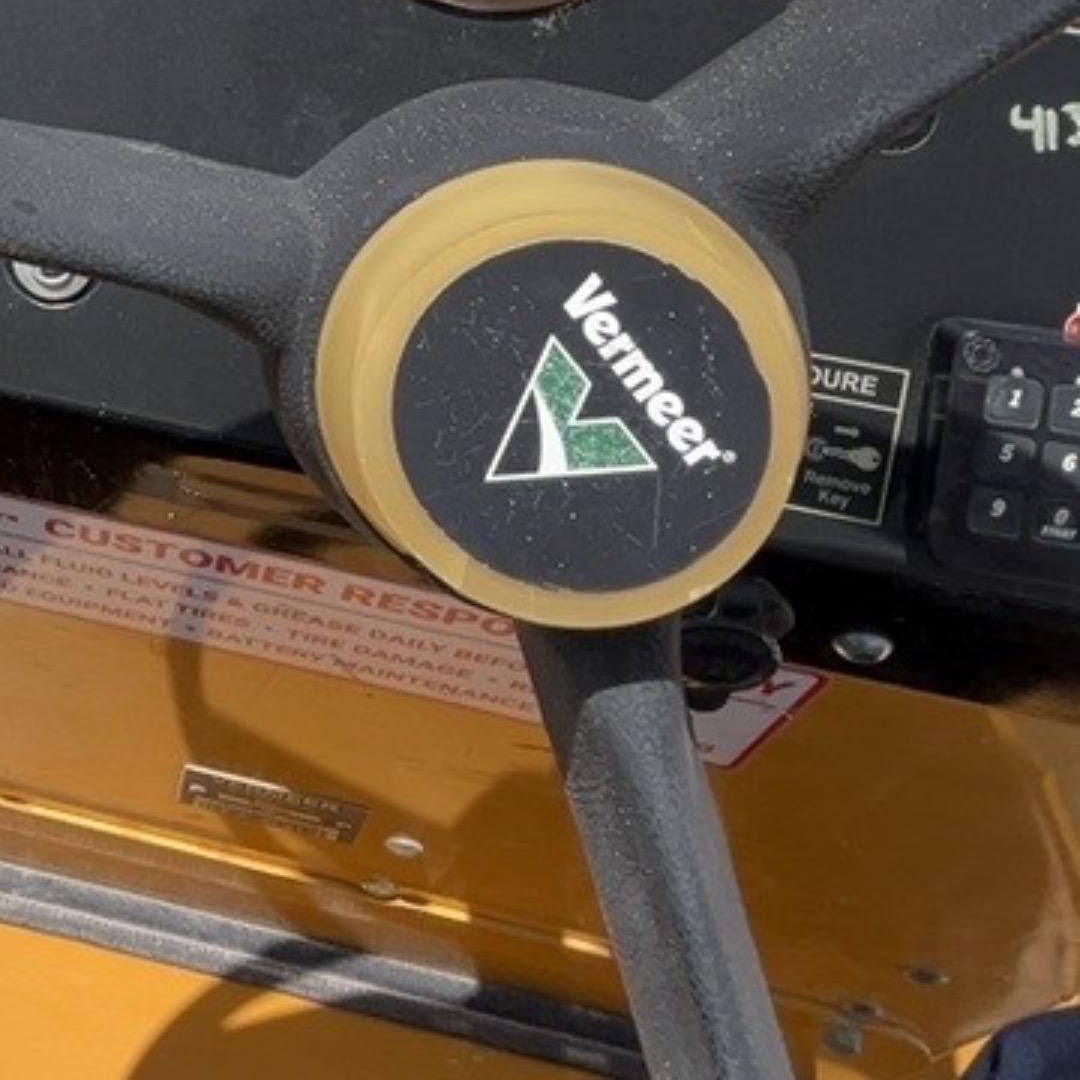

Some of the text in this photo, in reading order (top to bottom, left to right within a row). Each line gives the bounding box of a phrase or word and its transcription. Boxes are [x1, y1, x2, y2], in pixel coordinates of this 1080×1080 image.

[561, 271, 723, 469] Vermeer
[1007, 389, 1023, 409] 1
[998, 442, 1017, 463] 5
[1061, 452, 1079, 473] 6
[804, 470, 871, 497] Remove
[818, 487, 854, 512] Key
[989, 496, 1007, 518] 9
[44, 518, 326, 595] CUSTOMER
[41, 553, 114, 580] FLUID
[121, 570, 219, 603] LEVELS
[251, 601, 362, 636] GREASE
[369, 628, 449, 653] DAILY
